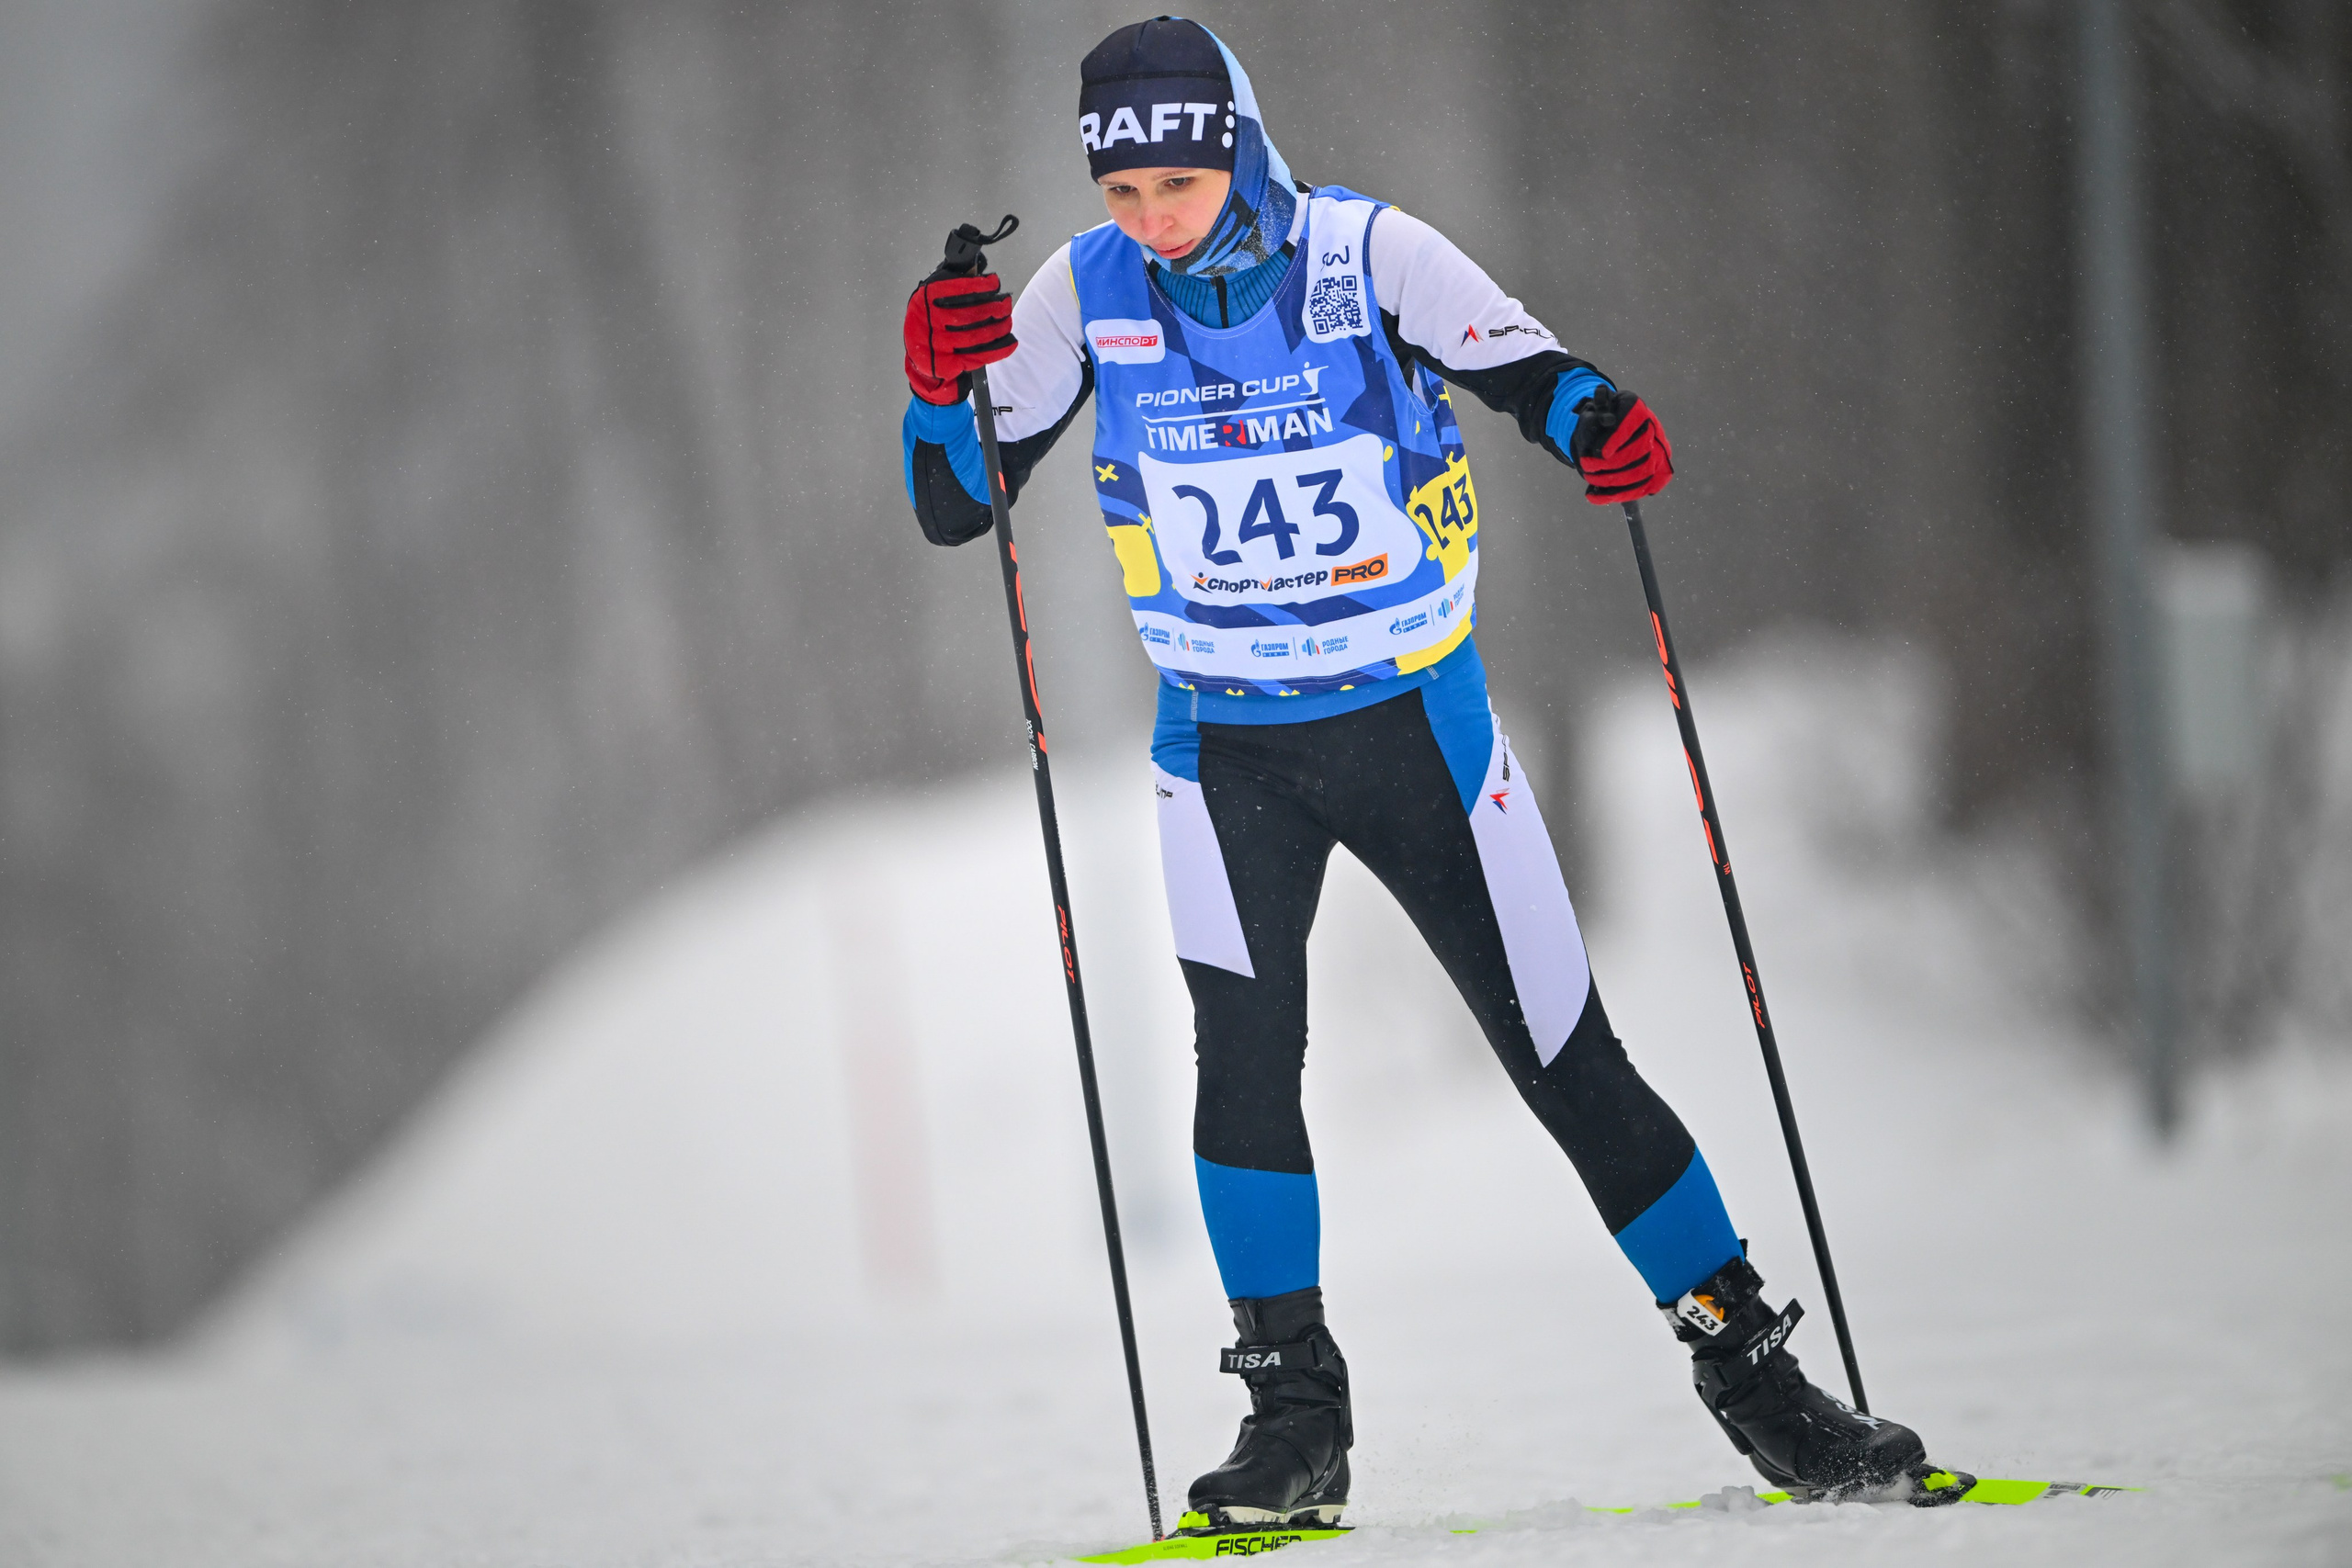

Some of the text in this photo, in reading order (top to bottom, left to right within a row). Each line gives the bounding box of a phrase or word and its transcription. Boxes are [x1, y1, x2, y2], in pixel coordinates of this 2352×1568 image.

[1136, 375, 1300, 407] PIONER CUP
[1145, 407, 1333, 451] TIMERMAN
[1171, 468, 1360, 566] 243
[1414, 472, 1474, 550] 243
[1261, 642, 1289, 651] ГАЗПРОМ
[1322, 636, 1349, 648] РОДНЫЕ
[1323, 643, 1349, 655] ГОРОДА
[1686, 1305, 1719, 1332] 243
[1747, 1314, 1792, 1366] TISA
[1227, 1351, 1282, 1370] TISA
